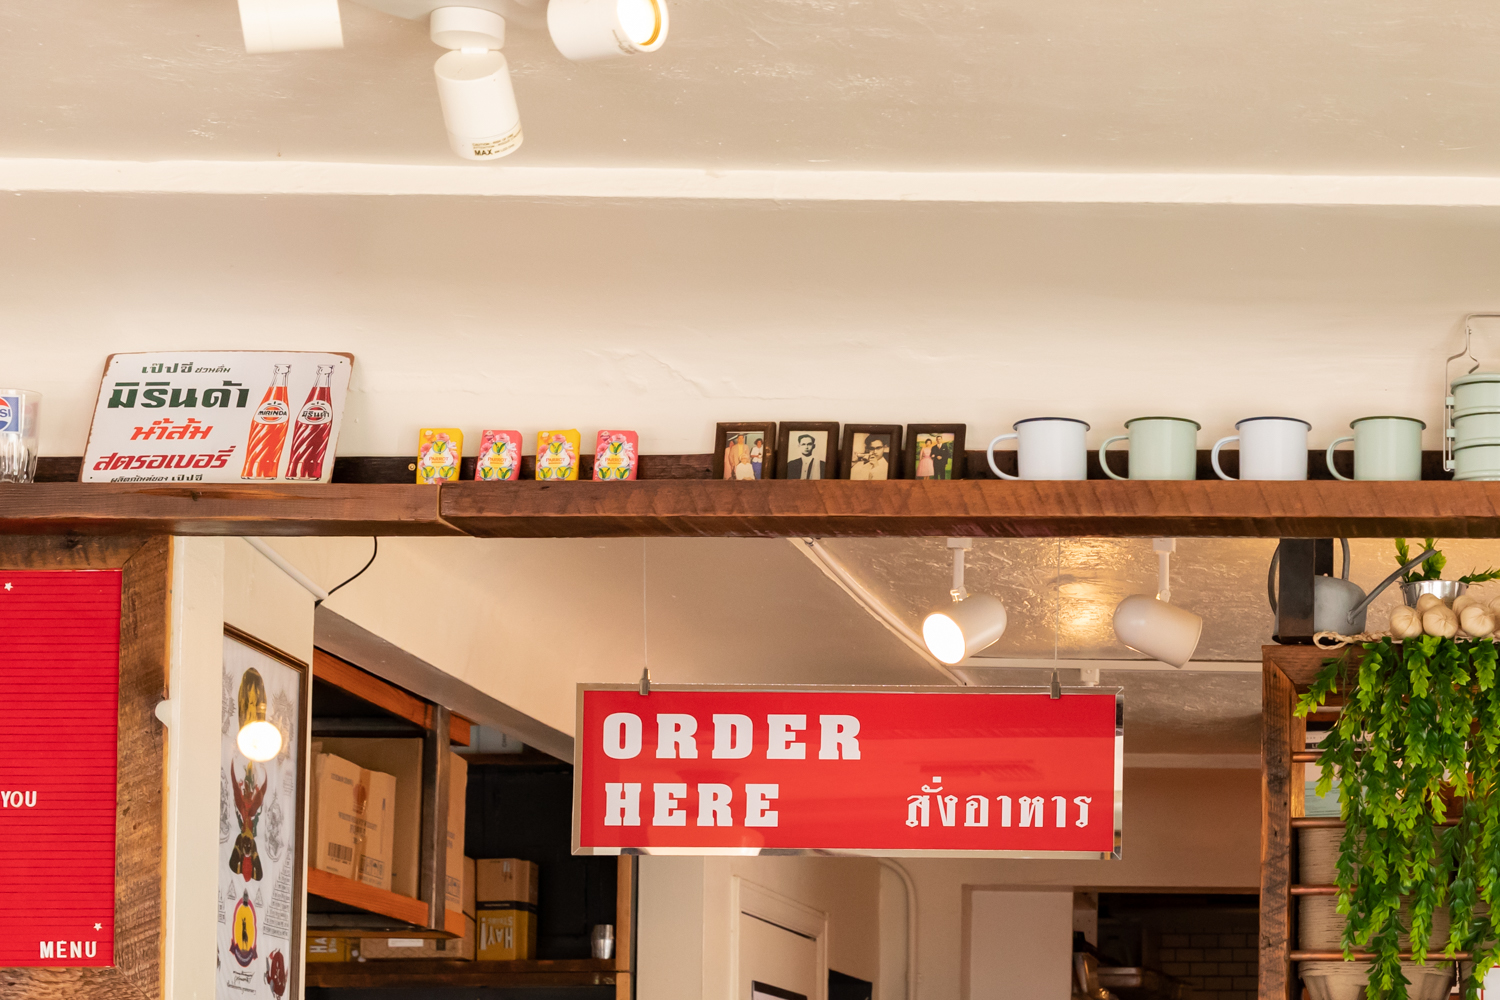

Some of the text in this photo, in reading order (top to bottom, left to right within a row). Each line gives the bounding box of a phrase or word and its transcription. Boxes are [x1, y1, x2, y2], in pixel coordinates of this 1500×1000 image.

[107, 380, 249, 408] มิรินด้า
[130, 418, 214, 440] น้ำส้ม
[602, 712, 862, 760] ORDER
[1, 790, 38, 808] YOU
[604, 782, 780, 828] HERE
[905, 776, 1092, 828] สั่งอาหาร
[39, 940, 98, 958] MENU
